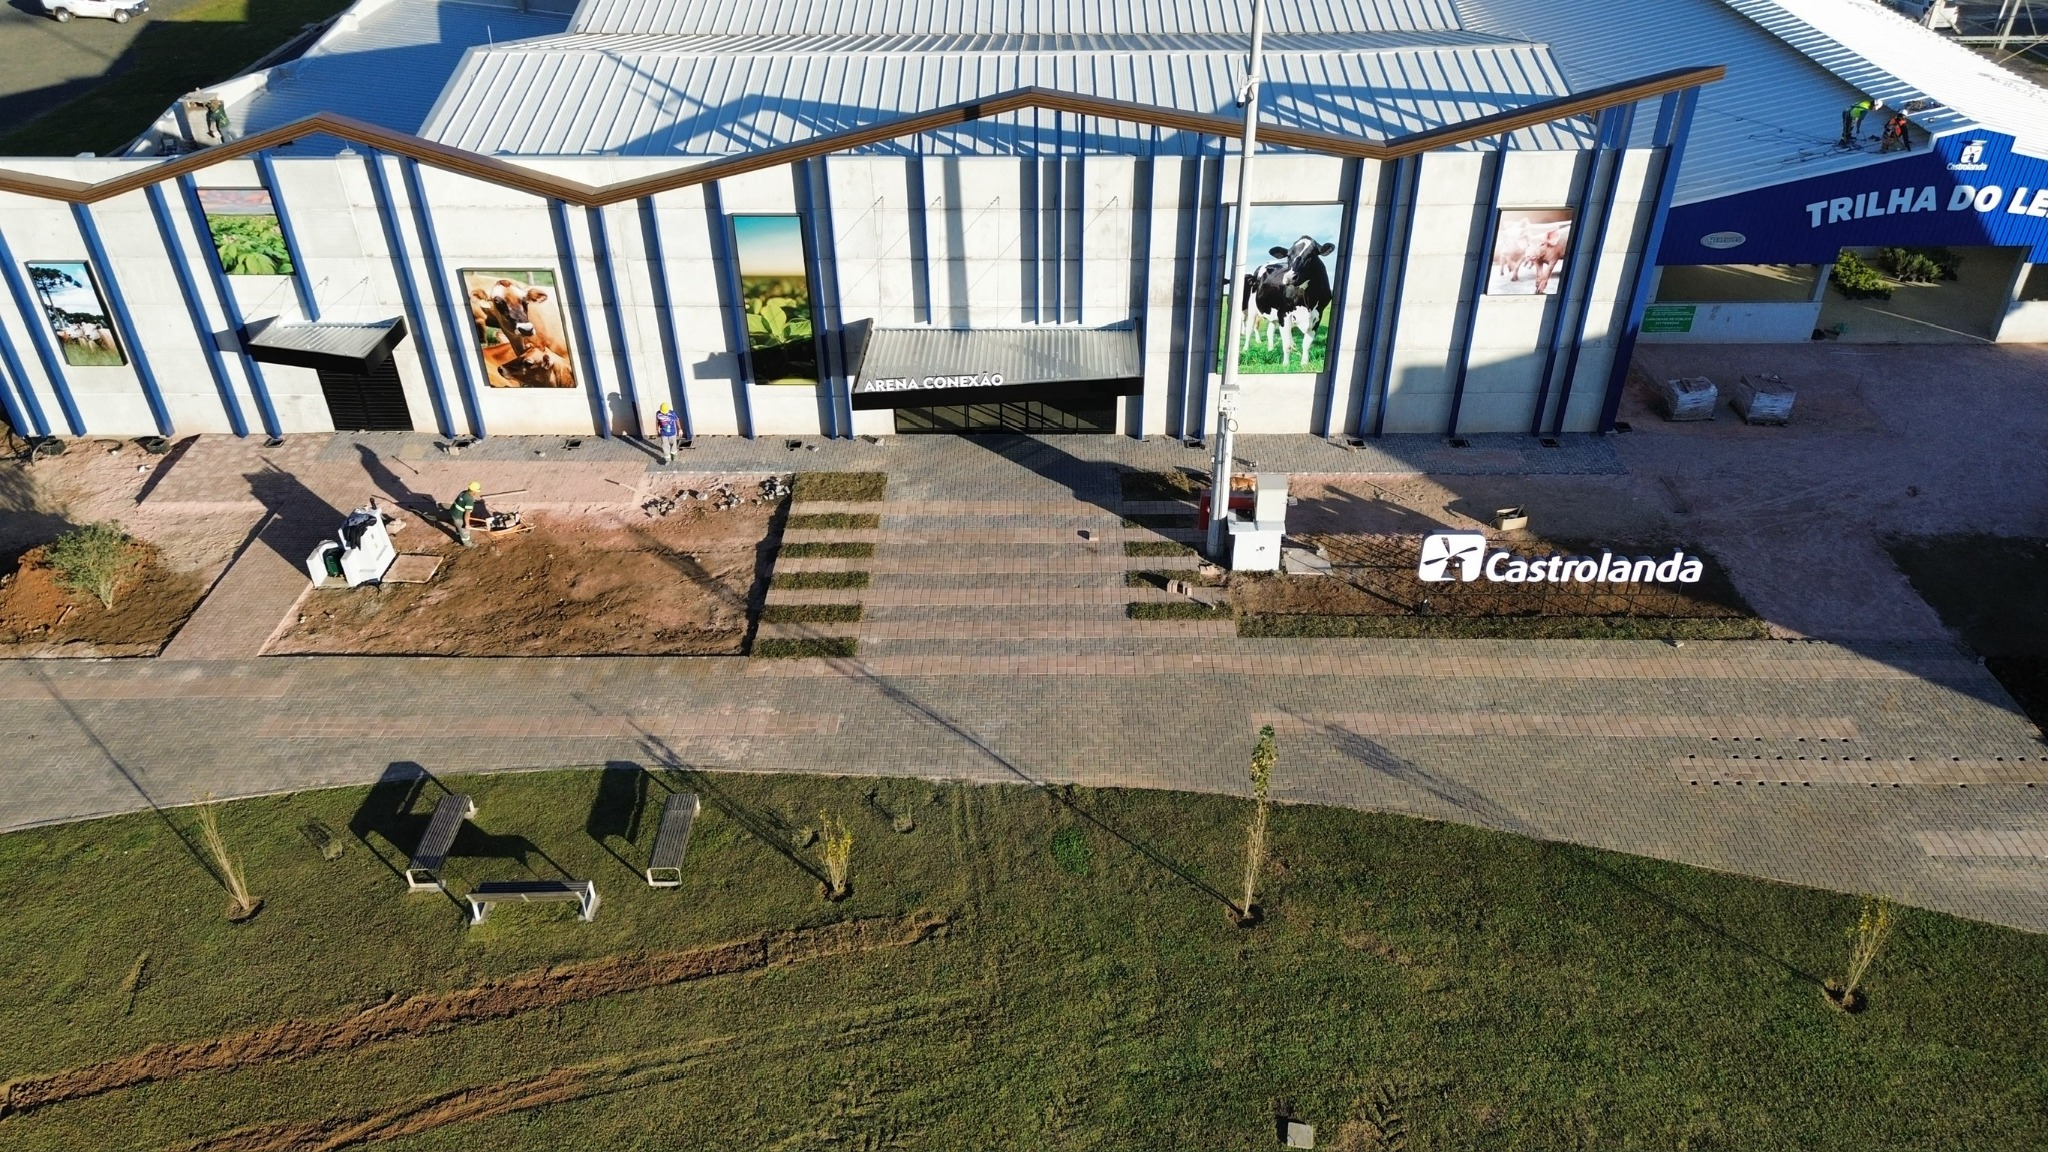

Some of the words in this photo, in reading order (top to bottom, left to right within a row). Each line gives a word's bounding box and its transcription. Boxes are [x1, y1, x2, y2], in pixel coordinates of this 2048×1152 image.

[1946, 162, 1989, 171] Castrolanda
[1806, 186, 1937, 228] TRILHA
[1946, 185, 2003, 213] DO
[2006, 186, 2048, 219] LE
[864, 378, 920, 392] ARENA
[923, 371, 1004, 389] CONEXÃO
[1486, 552, 1704, 583] Castrolanda
